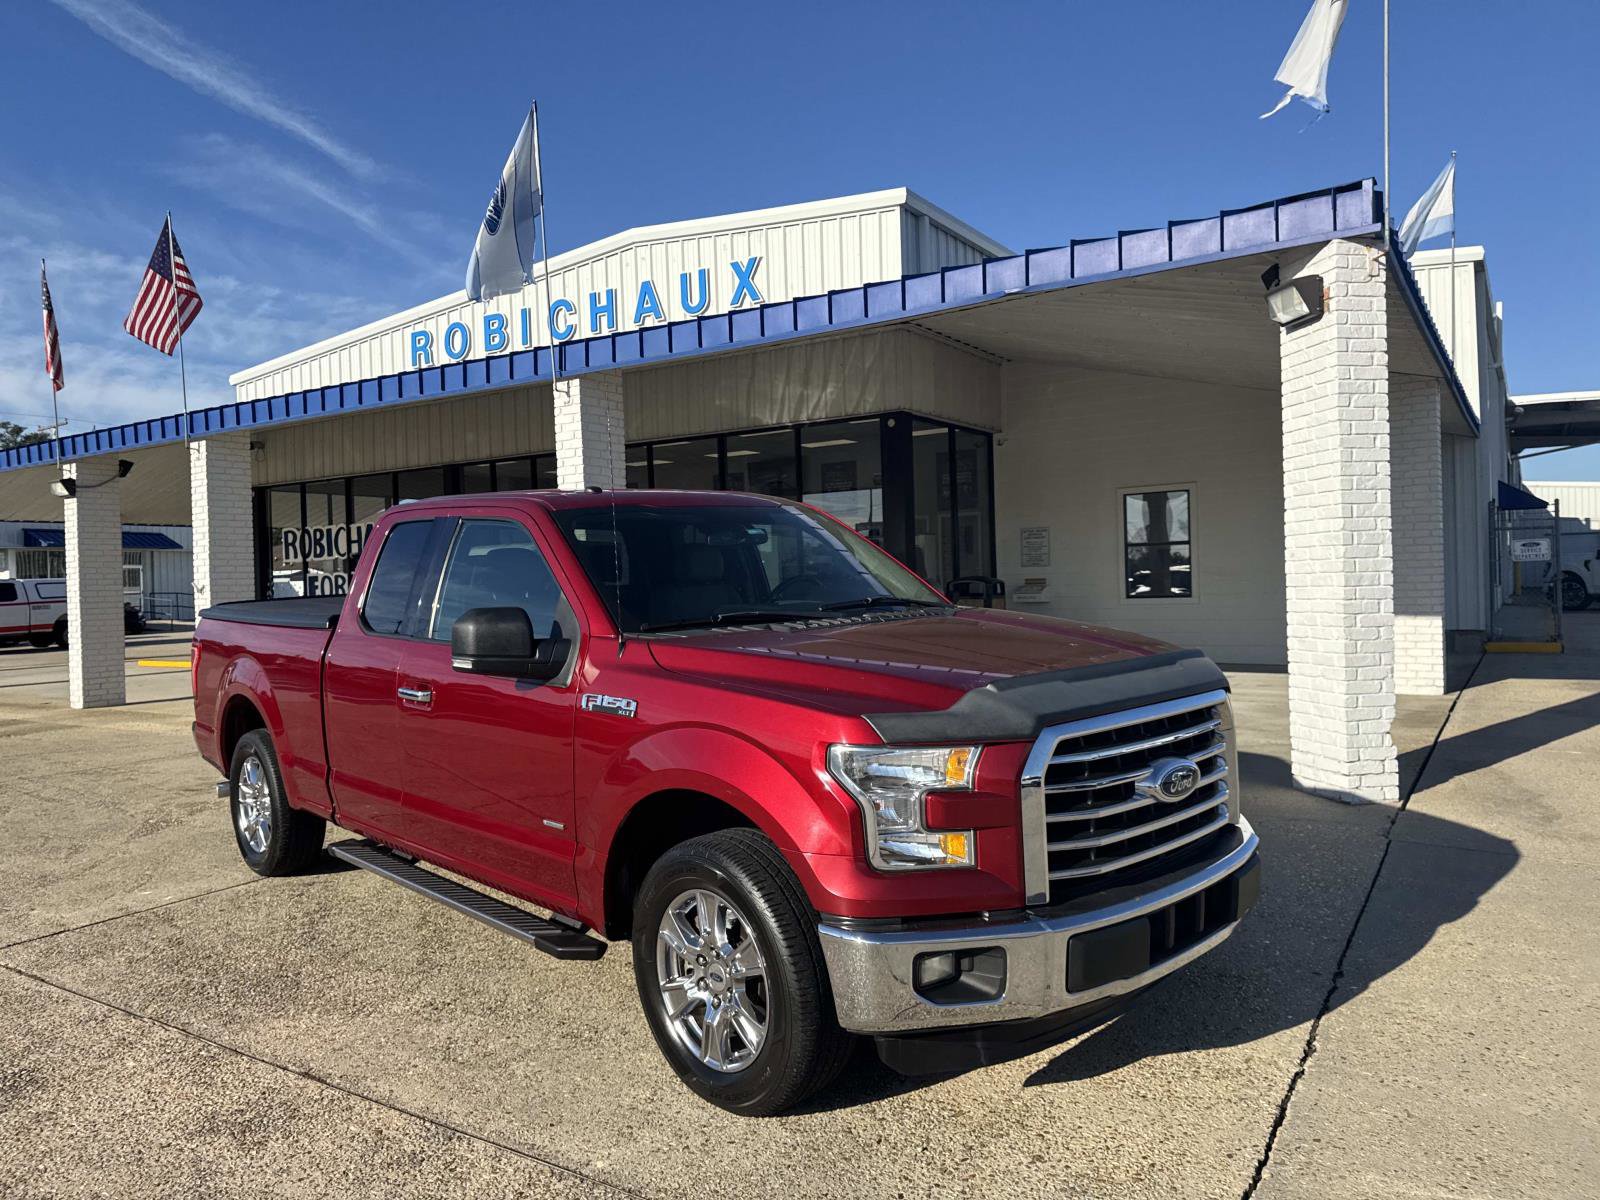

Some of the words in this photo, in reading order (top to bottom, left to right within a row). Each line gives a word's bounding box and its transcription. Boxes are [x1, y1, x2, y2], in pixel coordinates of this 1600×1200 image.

[411, 257, 764, 366] ROBICHAUX
[308, 573, 352, 596] FOR
[1170, 771, 1193, 793] Ford
